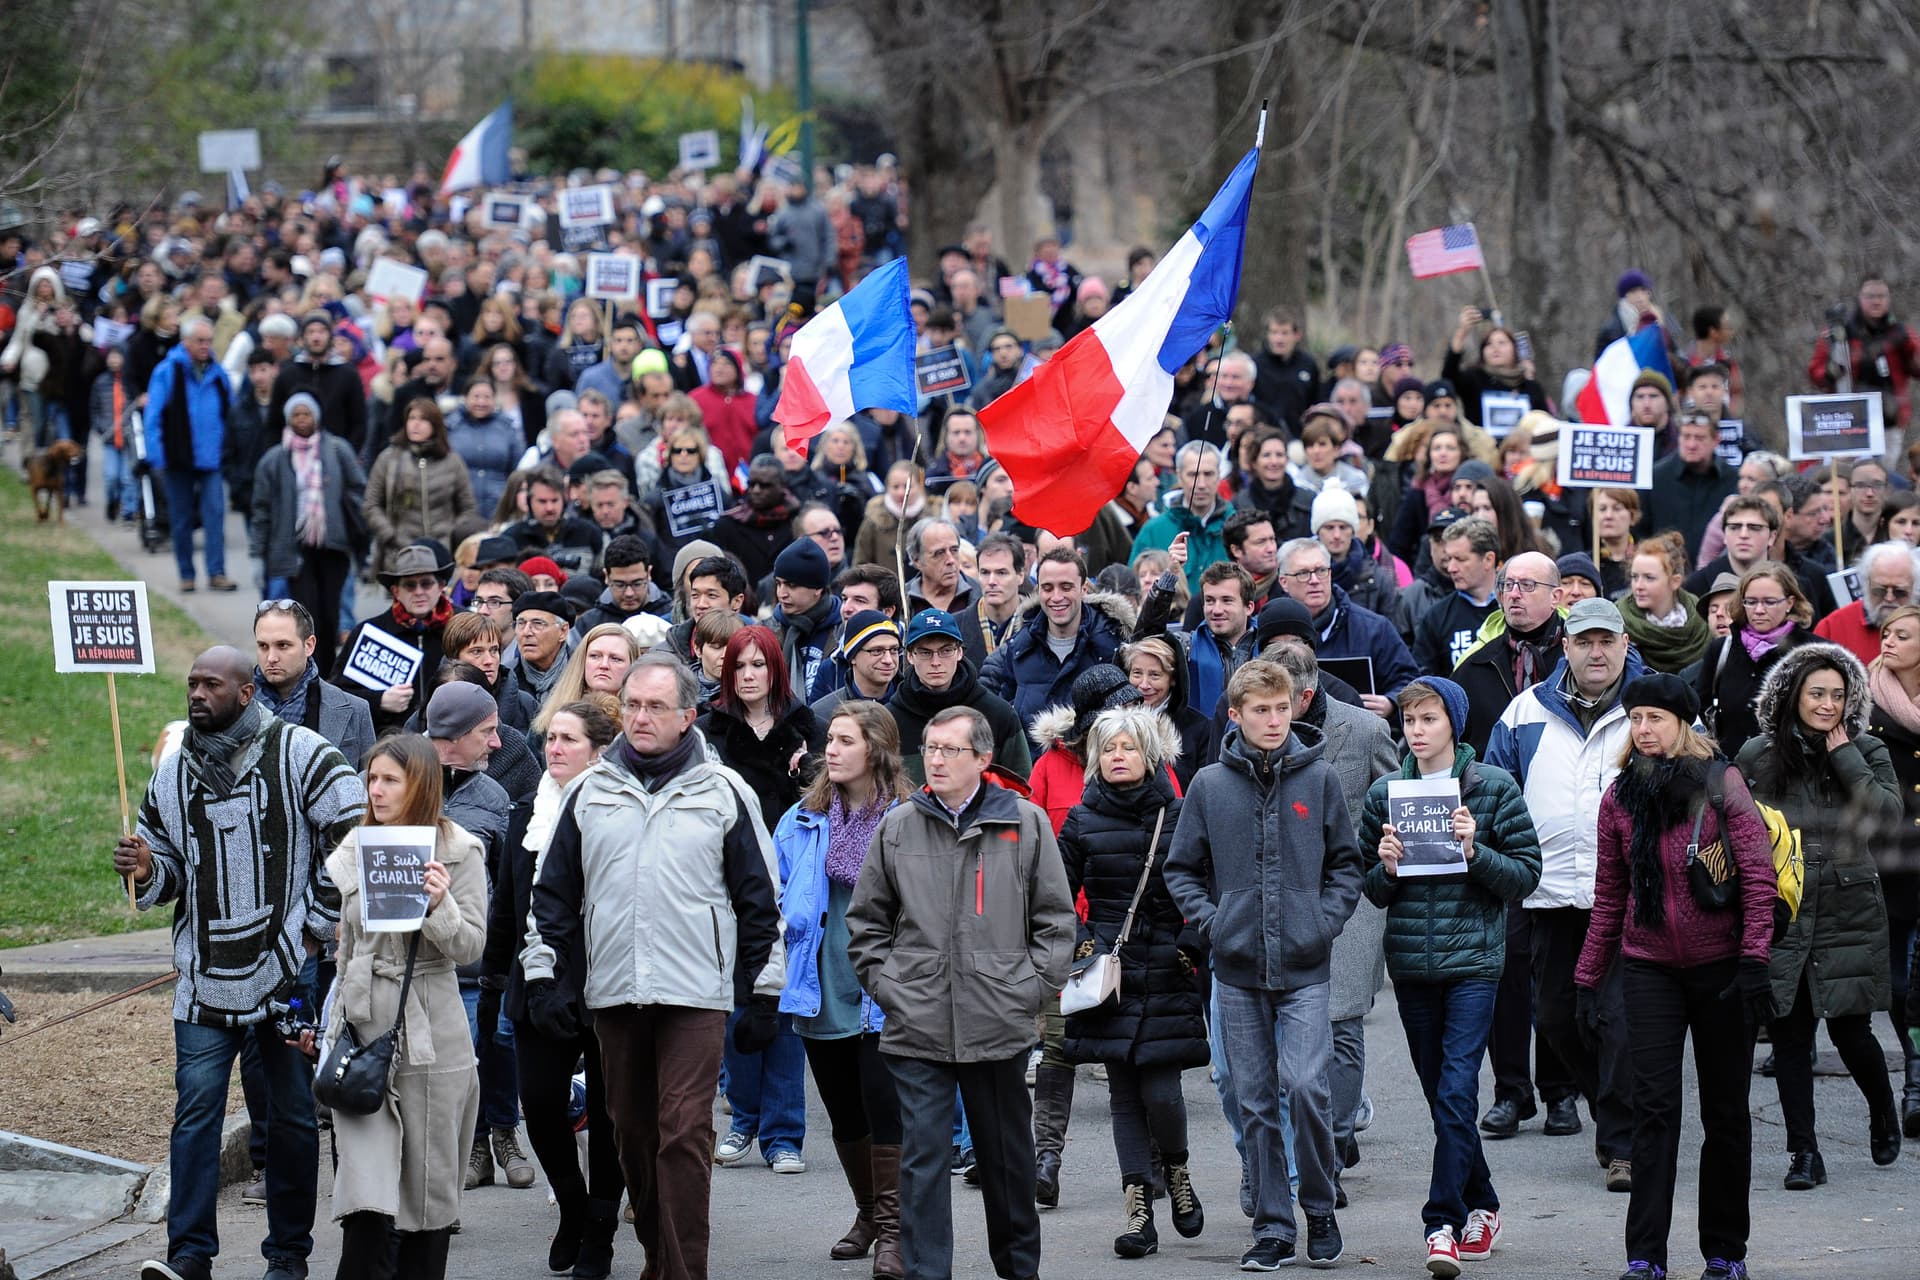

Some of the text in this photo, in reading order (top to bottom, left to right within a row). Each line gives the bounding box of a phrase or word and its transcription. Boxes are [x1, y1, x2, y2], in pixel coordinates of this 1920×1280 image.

[1574, 431, 1635, 448] JE SUIS
[1573, 454, 1634, 472] JE SUIS
[671, 492, 715, 515] CHARLIE
[71, 592, 131, 611] JE SUIS
[74, 626, 135, 645] JE SUIS
[1449, 629, 1472, 649] JE
[77, 646, 136, 659] LA RÉPUBLIQUE
[360, 641, 411, 674] JE SUIS
[354, 651, 407, 685] CHARLIE
[1400, 802, 1450, 818] Je suis
[1396, 816, 1455, 834] CHARLIE
[372, 850, 421, 867] Je suis
[369, 866, 425, 885] CHARLIE
